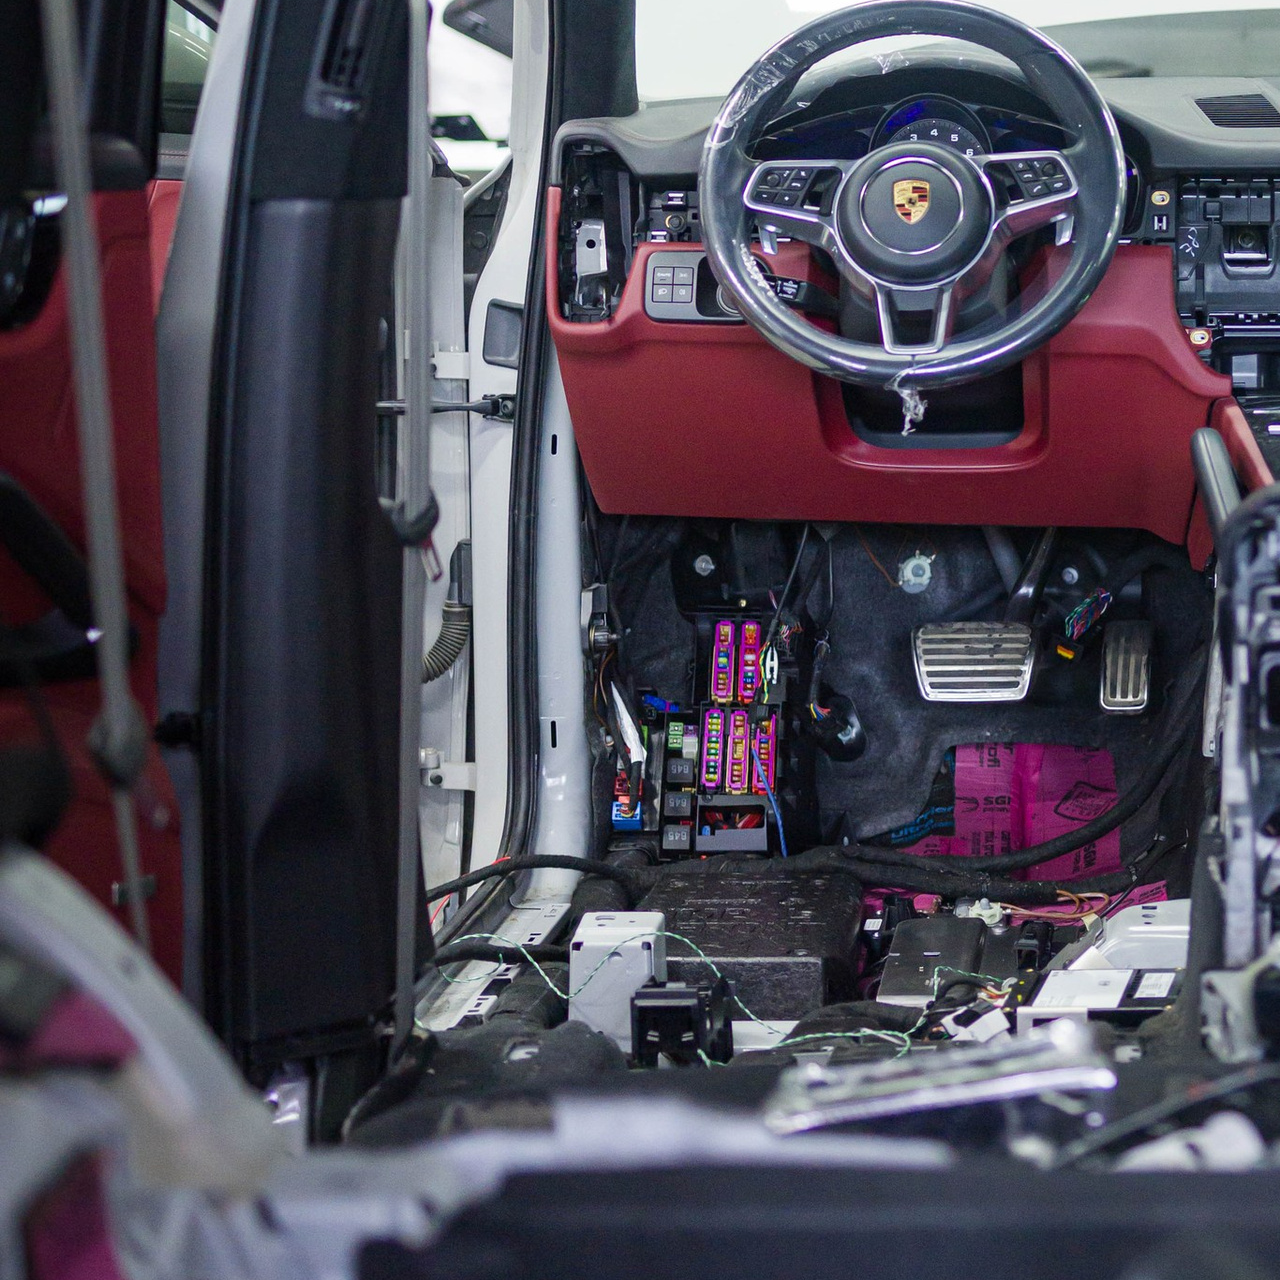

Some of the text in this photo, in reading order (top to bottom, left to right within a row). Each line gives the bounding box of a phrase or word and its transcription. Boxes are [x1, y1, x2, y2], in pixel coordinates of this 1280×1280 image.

[930, 128, 938, 136] 4
[951, 134, 959, 142] 5
[966, 149, 974, 157] 6
